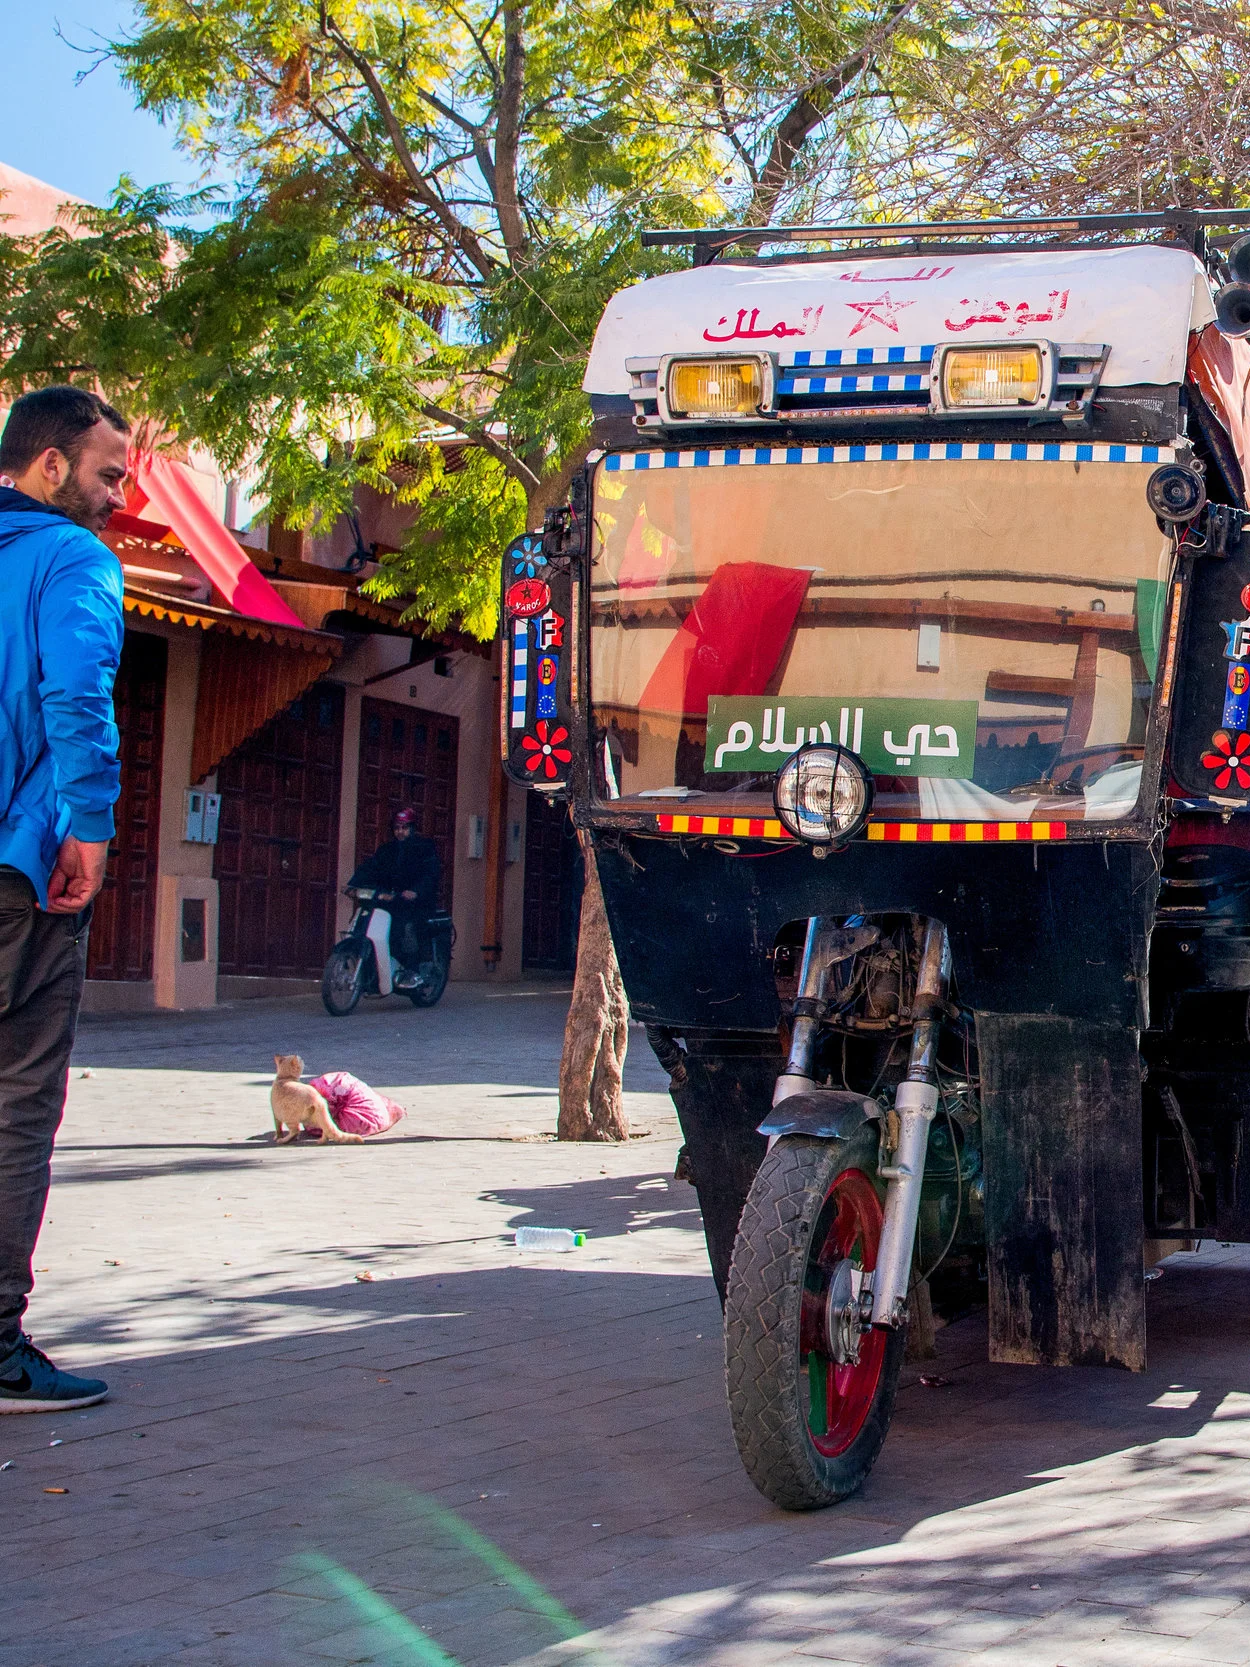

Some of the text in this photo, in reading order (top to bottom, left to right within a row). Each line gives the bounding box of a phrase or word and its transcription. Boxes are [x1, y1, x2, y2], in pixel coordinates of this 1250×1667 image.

[703, 304, 825, 342] الملك
[540, 618, 557, 648] F
[542, 664, 551, 679] E
[1233, 672, 1245, 689] E
[714, 706, 960, 768] حي السلام
